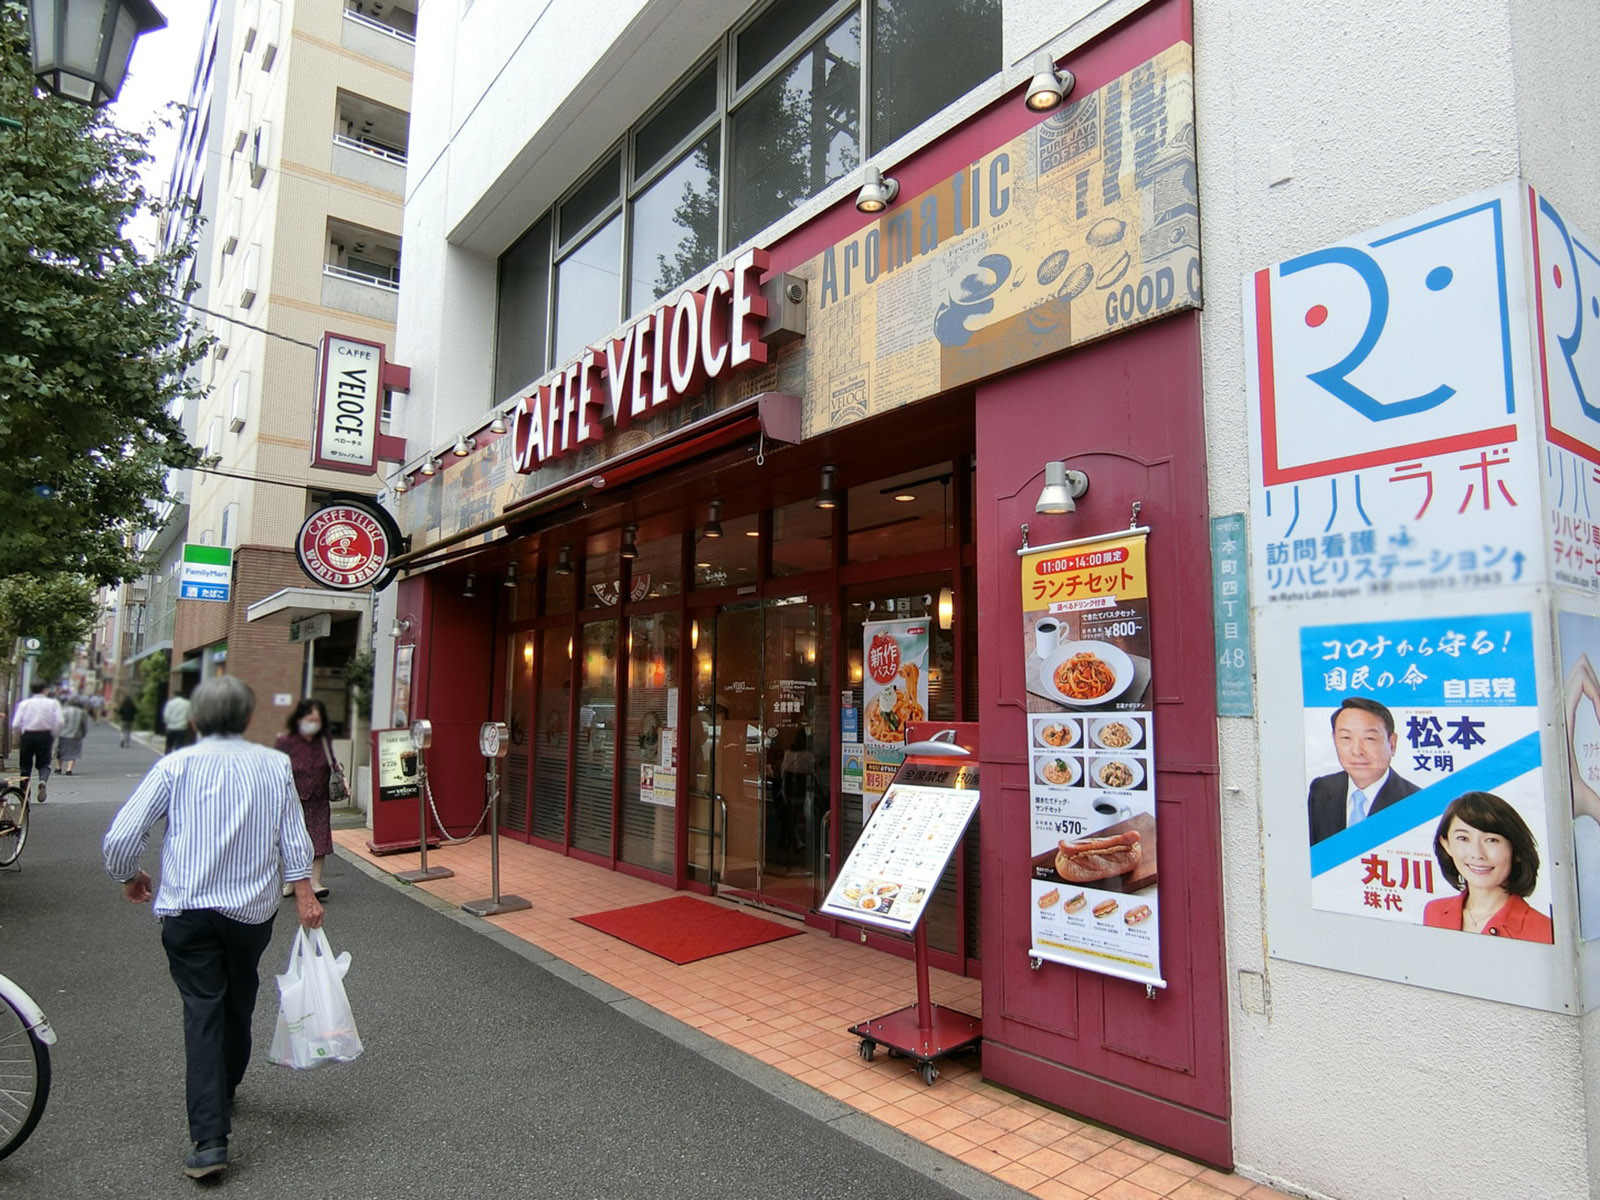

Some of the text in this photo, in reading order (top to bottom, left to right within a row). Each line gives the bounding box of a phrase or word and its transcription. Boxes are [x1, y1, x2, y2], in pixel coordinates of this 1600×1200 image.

[1040, 121, 1097, 158] PURE JAVA
[1041, 133, 1097, 171] COFFEE
[820, 153, 1010, 310] Aromatic
[1105, 267, 1174, 326] GOOD
[606, 248, 758, 427] VELOCE
[335, 369, 367, 437] VELOCE
[831, 387, 867, 410] VELOCE
[1266, 448, 1518, 538] リハラボ
[351, 511, 383, 542] VELOCE
[1266, 529, 1377, 566] 訪問看護
[185, 568, 228, 577] FamilyMart
[306, 549, 383, 584] WORLD BEANS
[1042, 559, 1068, 573] 11:00
[1267, 545, 1508, 590] リハビリステーション
[1032, 567, 1134, 600] ランチセット
[1221, 538, 1239, 640] 本町四丁目
[1056, 599, 1107, 611] 選べるドリンク付き
[1081, 609, 1136, 621] できたてパスタセット
[870, 642, 898, 668] 新作
[1219, 648, 1246, 669] 48
[873, 663, 897, 678] パスタ
[1323, 663, 1429, 692] 国民の命
[1443, 677, 1517, 699] 自民党
[1406, 715, 1486, 750] 松本
[902, 769, 950, 784] 全席禁煙
[1413, 754, 1454, 773] 文明
[866, 772, 884, 788] 割引
[1035, 805, 1063, 815] サンドセット
[1361, 853, 1434, 894] 丸川
[1363, 890, 1403, 912] 珠代
